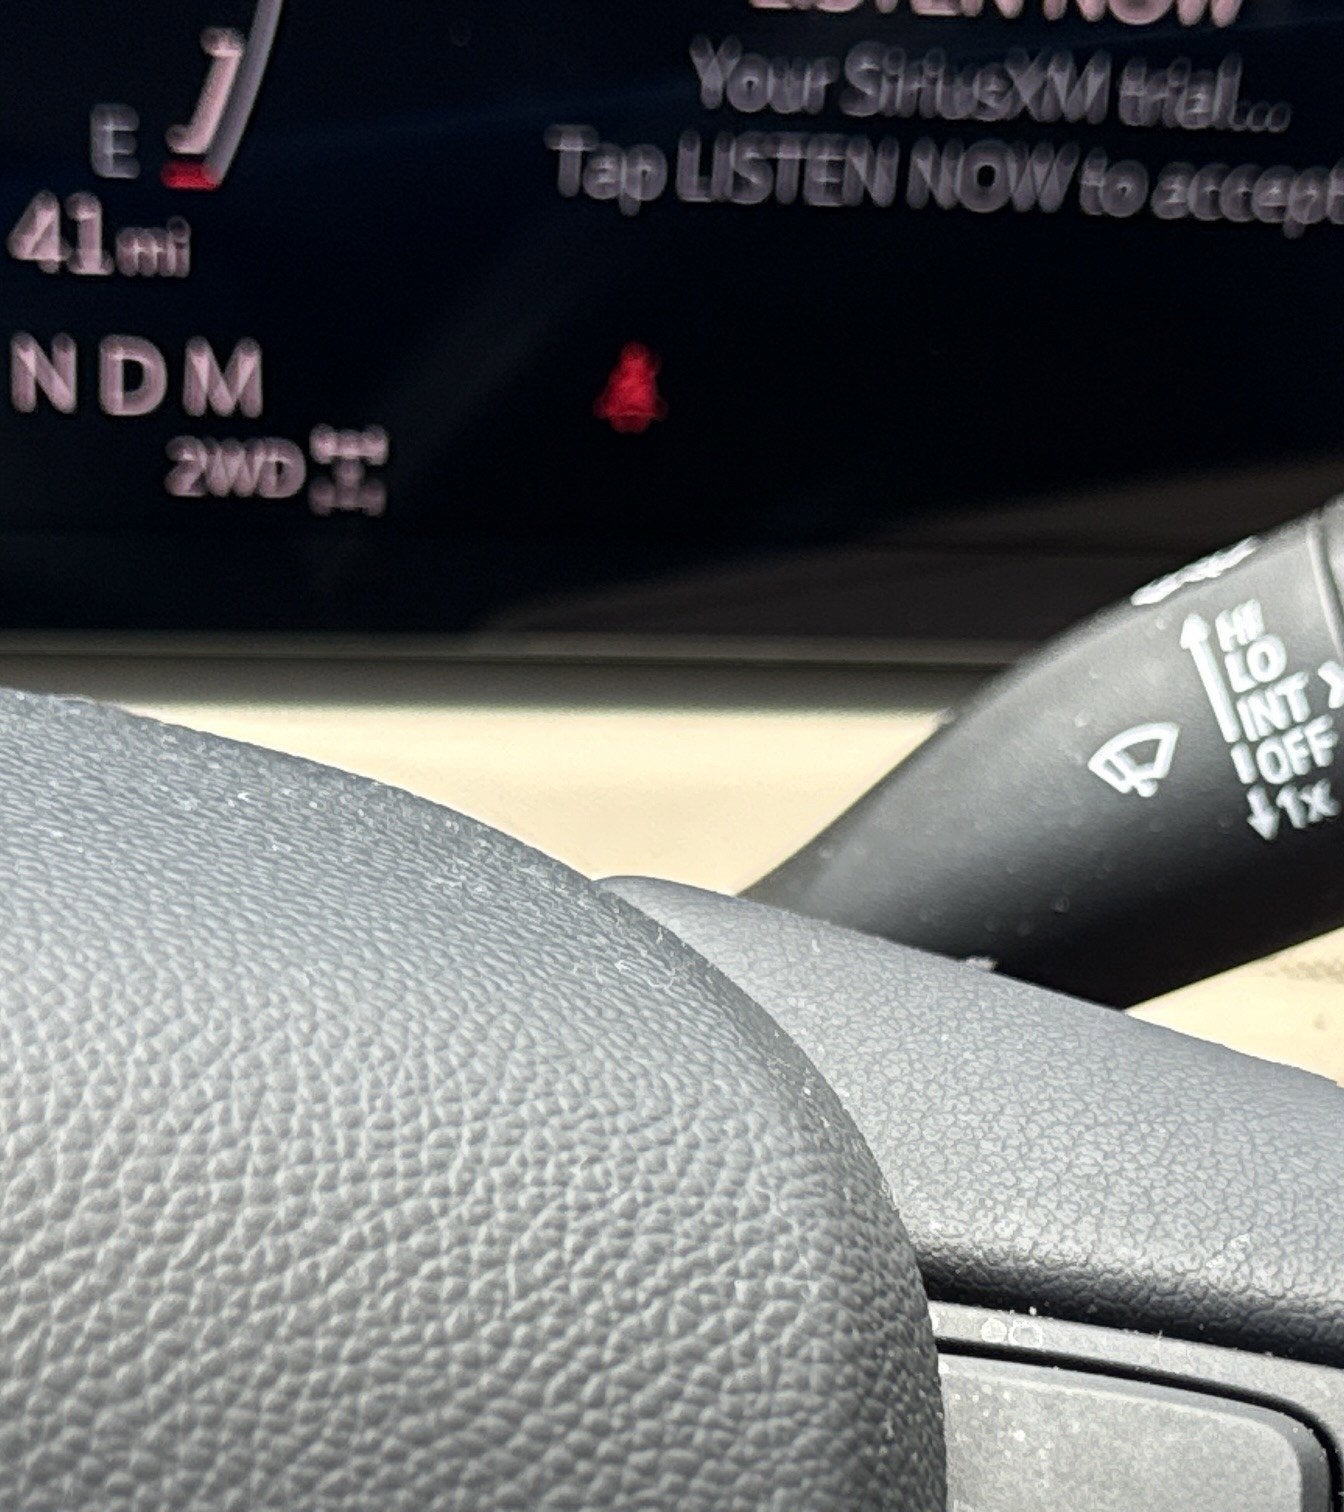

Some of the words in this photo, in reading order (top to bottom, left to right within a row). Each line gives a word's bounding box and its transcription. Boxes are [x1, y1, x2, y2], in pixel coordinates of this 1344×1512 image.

[690, 35, 838, 113] Your
[840, 41, 1112, 125] SiriusXM
[90, 103, 140, 179] E
[544, 124, 667, 216] Tap
[675, 130, 899, 208] LISTEN
[907, 138, 1080, 214] NOW
[1080, 146, 1149, 218] to
[165, 435, 307, 498] 2WD
[1215, 599, 1265, 652] HI
[1224, 634, 1287, 693] LO
[1236, 671, 1311, 742] INT
[1256, 714, 1339, 785] OFF
